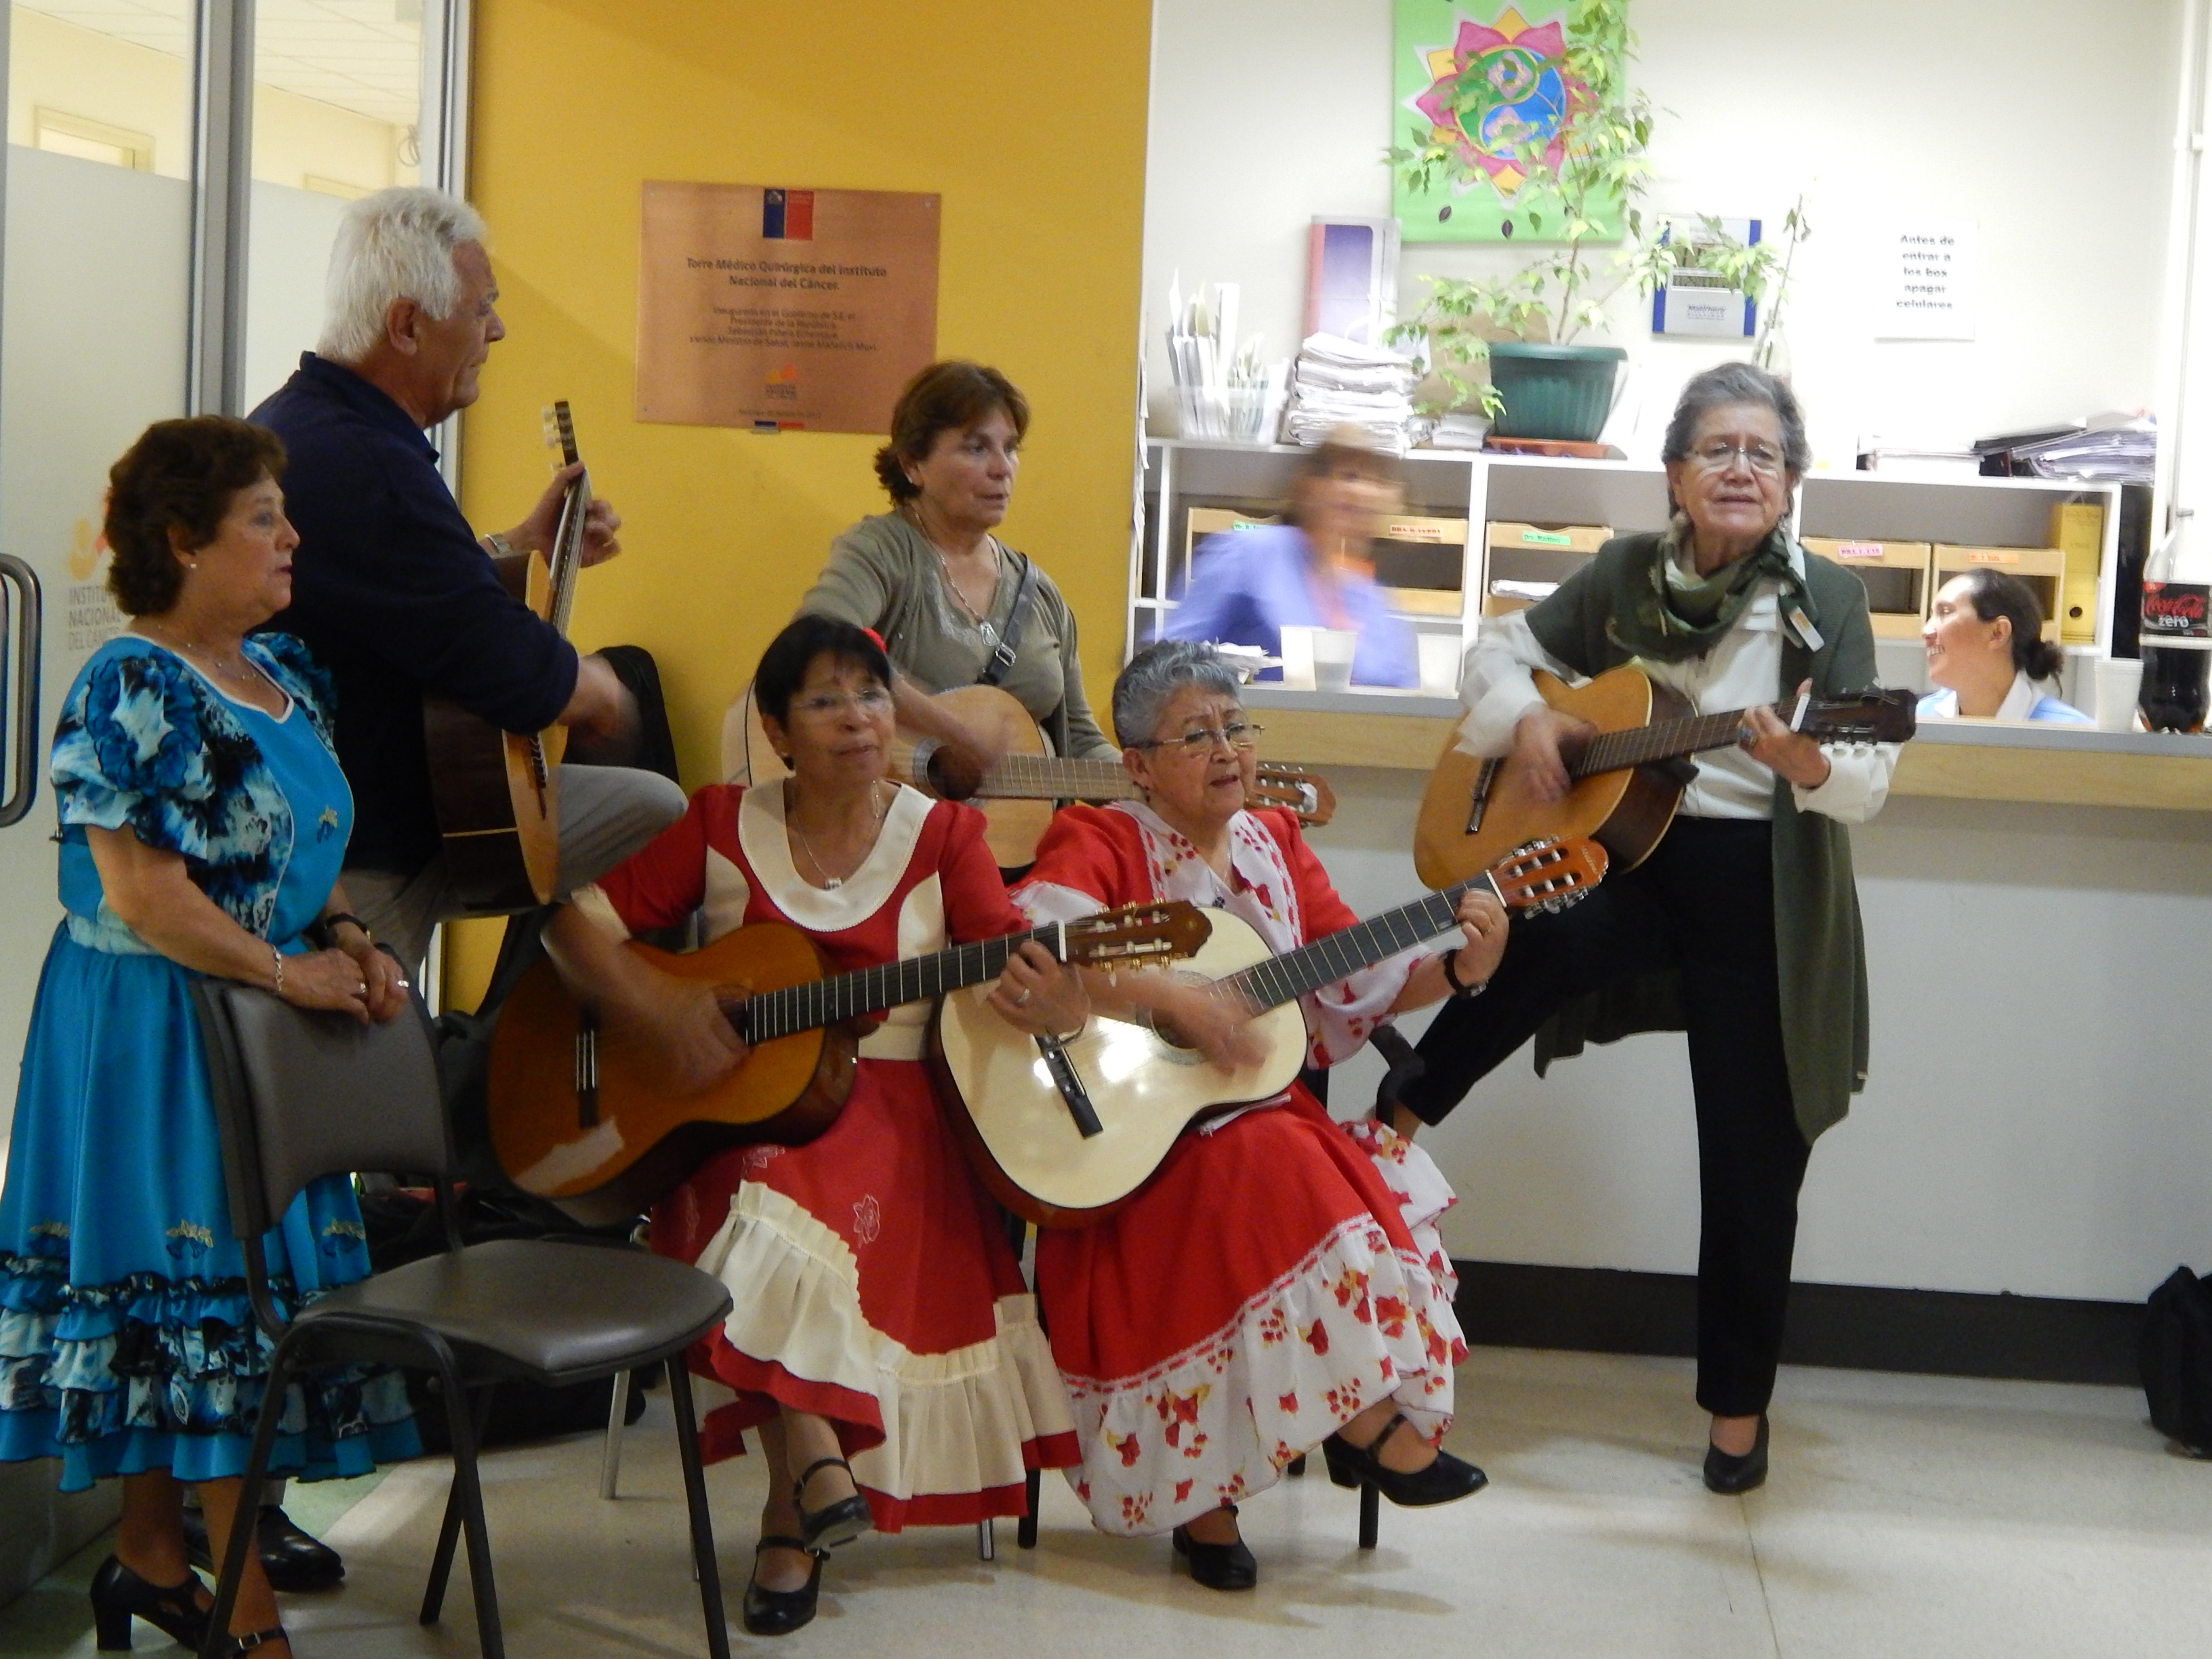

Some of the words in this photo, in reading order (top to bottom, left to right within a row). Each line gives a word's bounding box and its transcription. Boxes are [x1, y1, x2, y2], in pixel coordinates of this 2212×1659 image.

[1900, 234, 1936, 245] Antes
[1940, 234, 1955, 246] de
[1902, 251, 1940, 262] entrar
[1944, 252, 1951, 262] a
[687, 257, 714, 270] Torre
[819, 264, 836, 275] del
[839, 265, 888, 278] Instituto
[1903, 266, 1922, 277] los
[1925, 267, 1948, 278] box
[729, 275, 777, 288] Nacional
[780, 276, 798, 289] del
[1904, 283, 1947, 295] apagar
[1896, 298, 1953, 310] celulares
[2145, 593, 2206, 619] Coca-Cola
[2157, 614, 2189, 628] zero
